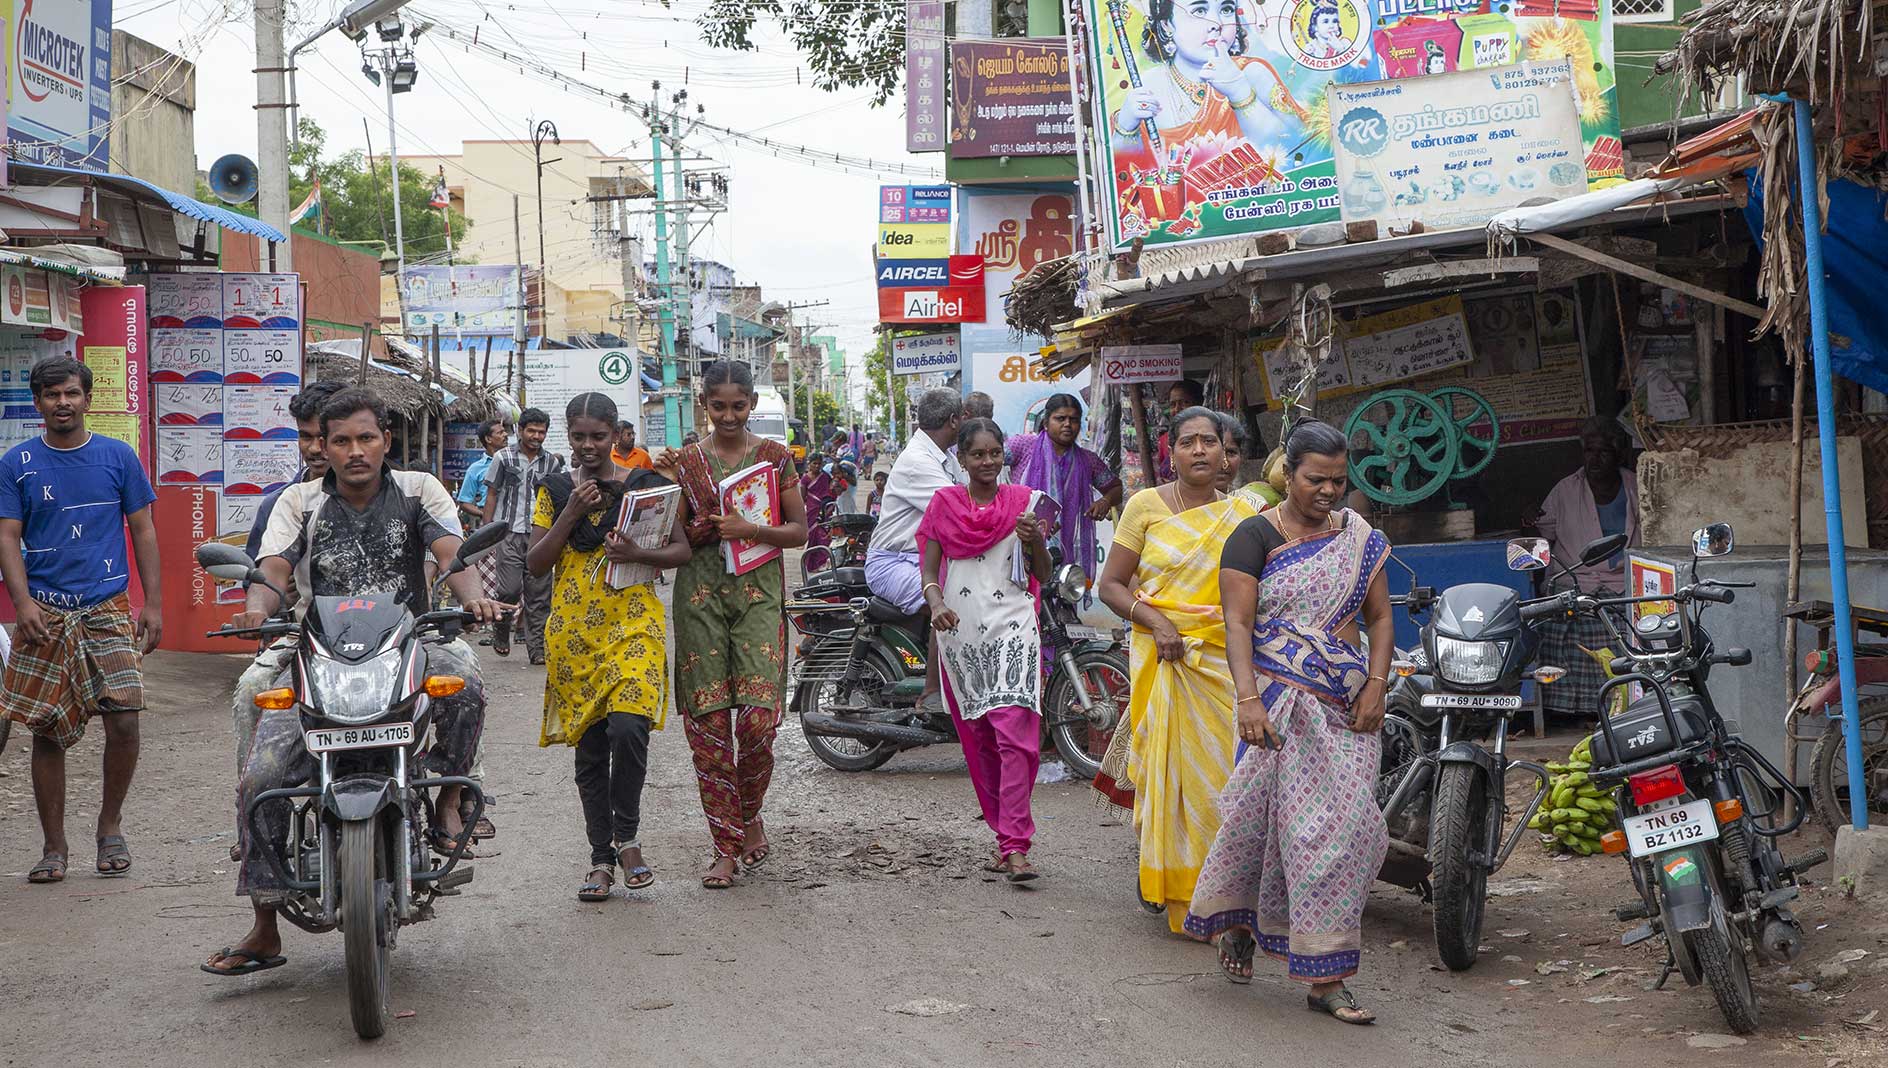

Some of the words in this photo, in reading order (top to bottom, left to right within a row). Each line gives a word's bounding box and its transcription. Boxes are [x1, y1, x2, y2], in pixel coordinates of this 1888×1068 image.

[23, 18, 86, 81] MICROTEK
[1474, 37, 1510, 54] PUPPY
[1298, 53, 1329, 69] TRADE
[1330, 48, 1359, 67] MARK
[23, 67, 65, 95] INVERTERS
[69, 88, 84, 103] UPS
[1343, 118, 1385, 145] RR
[887, 191, 902, 202] 10
[887, 209, 901, 220] 25
[1224, 200, 1286, 220] பேன்ஸி
[1290, 200, 1313, 215] ரக
[879, 266, 947, 280] AIRCEL
[160, 294, 181, 310] 50
[187, 296, 211, 312] 50
[233, 288, 246, 306] 1
[271, 286, 284, 306] 1
[907, 298, 962, 317] Airtel
[122, 298, 137, 354] மையம்
[161, 347, 184, 363] 50
[189, 348, 211, 365] 50
[230, 347, 250, 363] 50
[264, 349, 283, 363] 50
[896, 350, 958, 370] மெடிக்கல்ஸ்
[1124, 359, 1137, 368] NO
[1139, 358, 1180, 368] SMOKING
[606, 358, 622, 377] 4
[20, 450, 31, 465] D
[43, 485, 55, 501] K
[71, 524, 82, 539] N
[104, 559, 113, 573] Y
[192, 541, 204, 606] NWORK
[36, 590, 83, 607] D.K.N.Y
[343, 643, 364, 652] TVS
[1435, 696, 1448, 705] TN
[1457, 696, 1469, 705] 69
[1472, 697, 1486, 706] AU
[1493, 697, 1517, 706] 9090
[316, 733, 332, 746] TN
[344, 731, 357, 744] 69
[360, 729, 376, 743] AU
[384, 726, 409, 741] 1705
[1627, 732, 1655, 749] TVS
[1644, 815, 1667, 831] TN
[1670, 810, 1688, 824] 69
[1644, 833, 1667, 849] BZ
[1669, 824, 1703, 843] 1132
